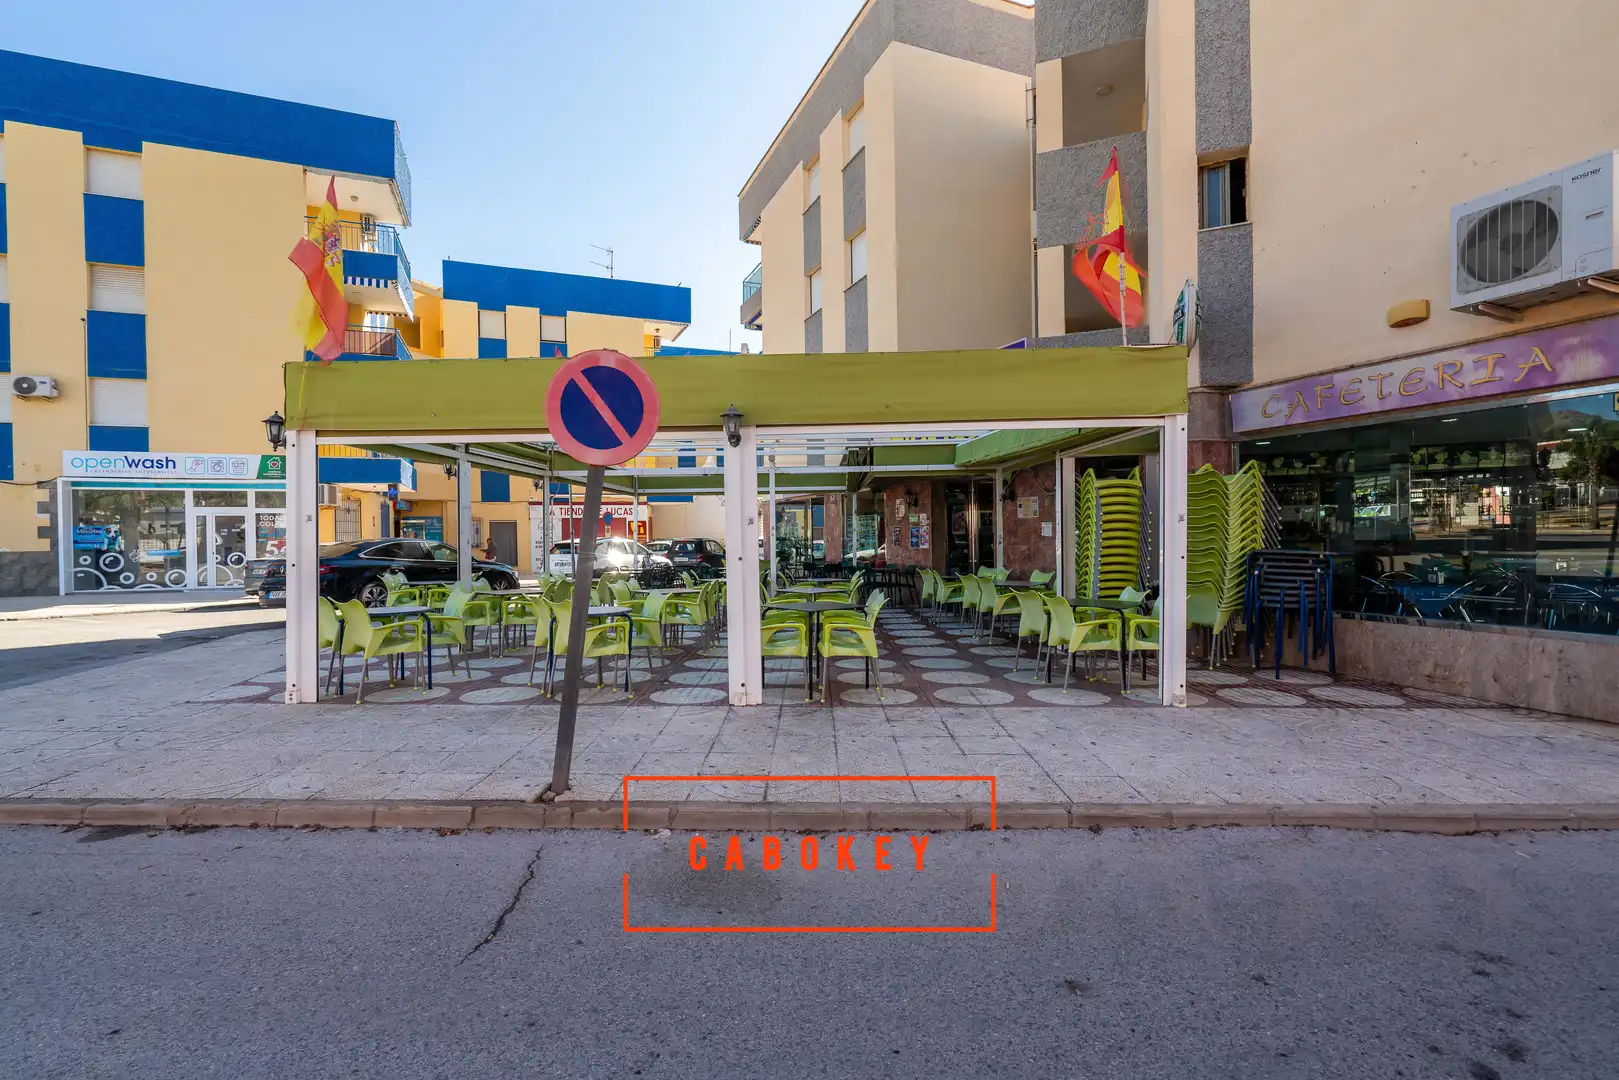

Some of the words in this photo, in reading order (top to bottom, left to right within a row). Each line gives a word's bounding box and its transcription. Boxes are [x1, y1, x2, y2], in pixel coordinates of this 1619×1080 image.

[1261, 346, 1554, 420] CAFETERIA
[71, 455, 177, 473] openwash
[559, 507, 584, 516] TIEND
